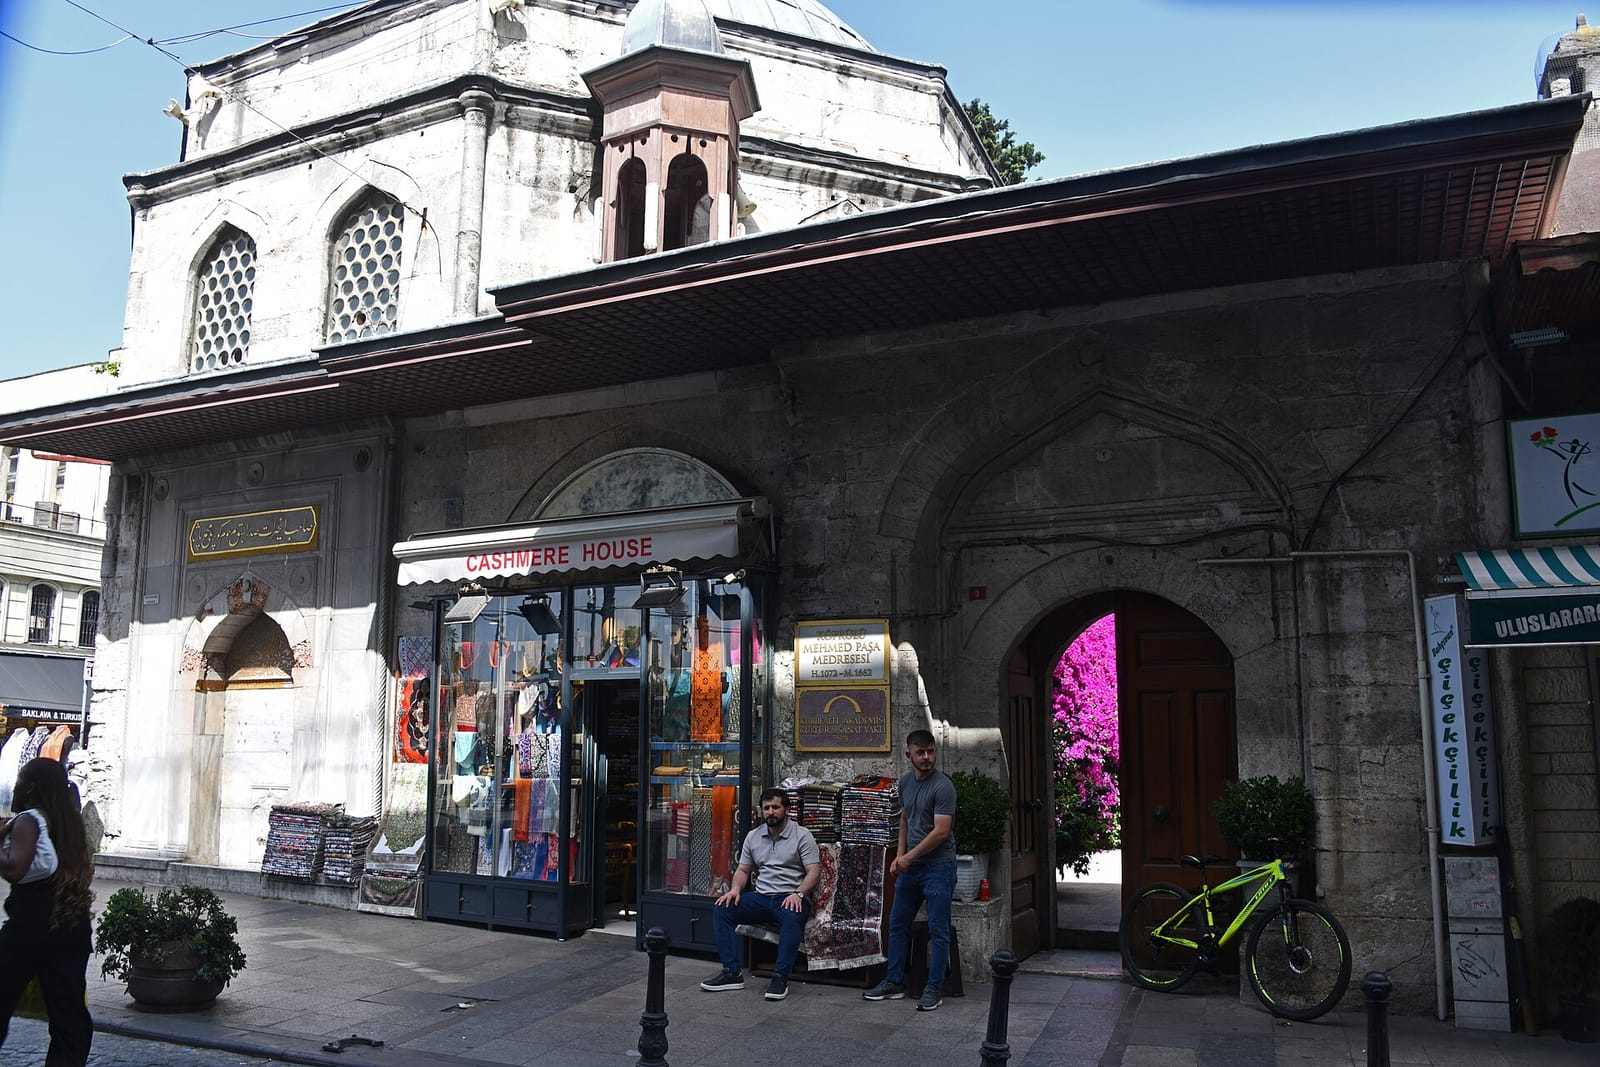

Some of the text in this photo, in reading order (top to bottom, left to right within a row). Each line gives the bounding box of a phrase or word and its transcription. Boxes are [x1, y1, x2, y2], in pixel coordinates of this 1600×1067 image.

[467, 537, 652, 572] CASHMERE HOUSE
[817, 627, 867, 641] KÖPRÜLÜ
[803, 641, 880, 654] MEHMED PAŞA
[812, 653, 870, 665] MEDRESESİ
[22, 709, 51, 719] BAKLAVA
[60, 713, 82, 721] TURKIS
